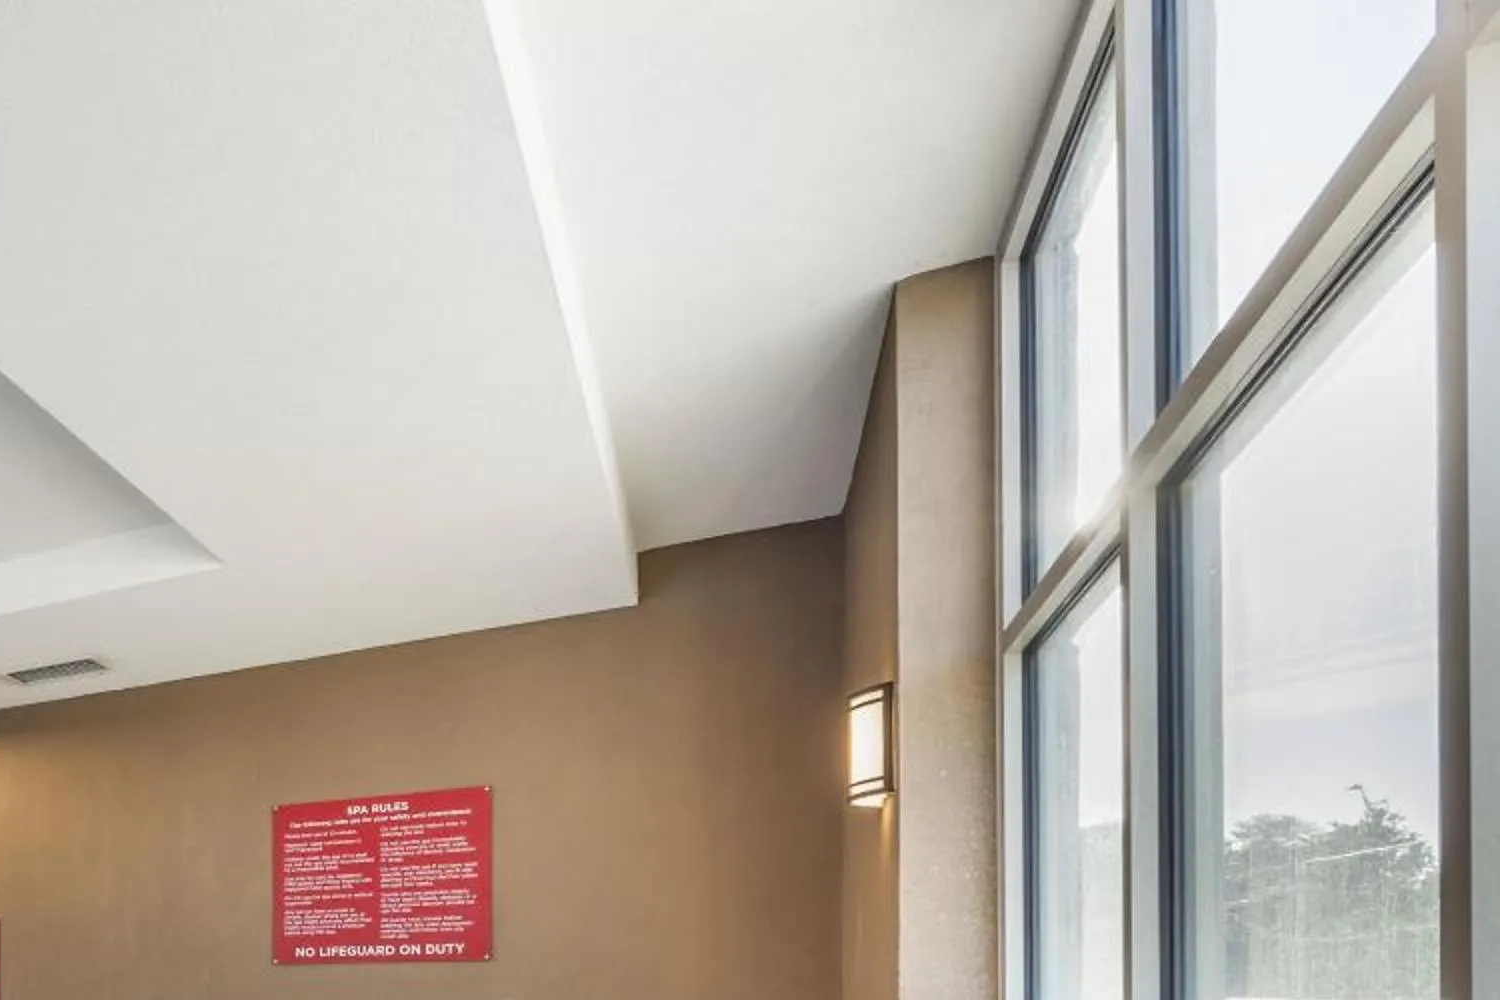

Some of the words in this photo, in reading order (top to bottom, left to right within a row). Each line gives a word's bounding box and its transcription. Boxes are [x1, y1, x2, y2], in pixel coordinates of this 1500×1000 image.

[371, 801, 409, 813] RULES
[295, 947, 315, 958] NO
[319, 945, 396, 957] LIFEGUARD
[400, 944, 421, 956] ON
[425, 943, 466, 955] DUTY
